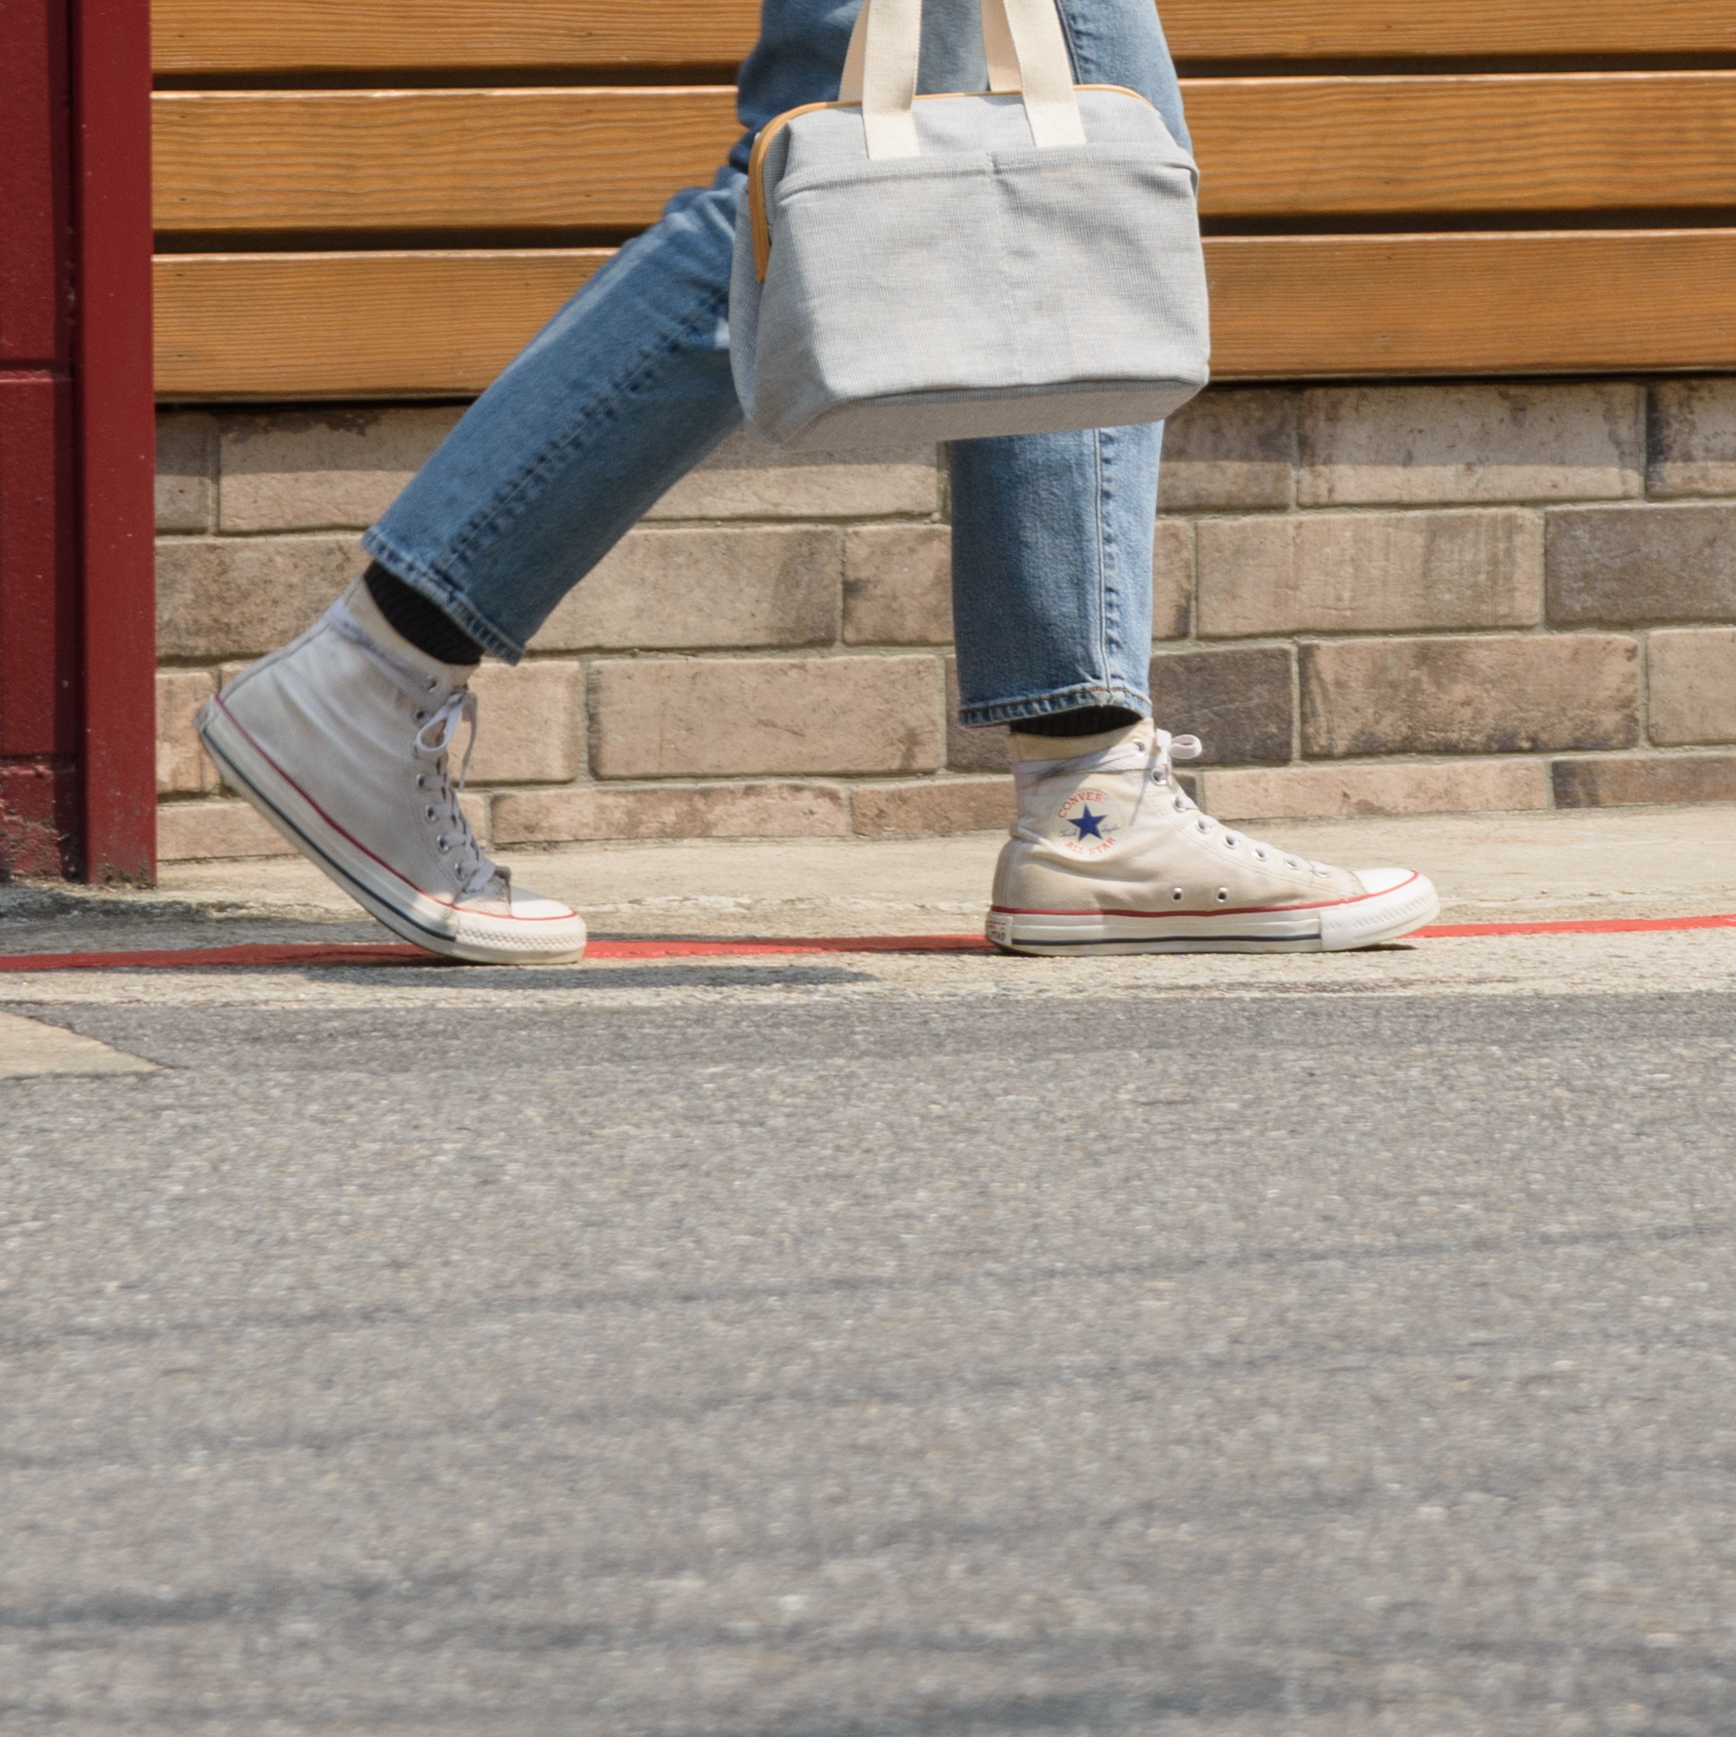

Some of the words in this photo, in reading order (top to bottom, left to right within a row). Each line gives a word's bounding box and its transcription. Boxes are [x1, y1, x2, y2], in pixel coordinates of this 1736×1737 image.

[1057, 791, 1110, 819] CONVER
[1064, 841, 1084, 855] ALL
[1088, 836, 1117, 856] STAR
